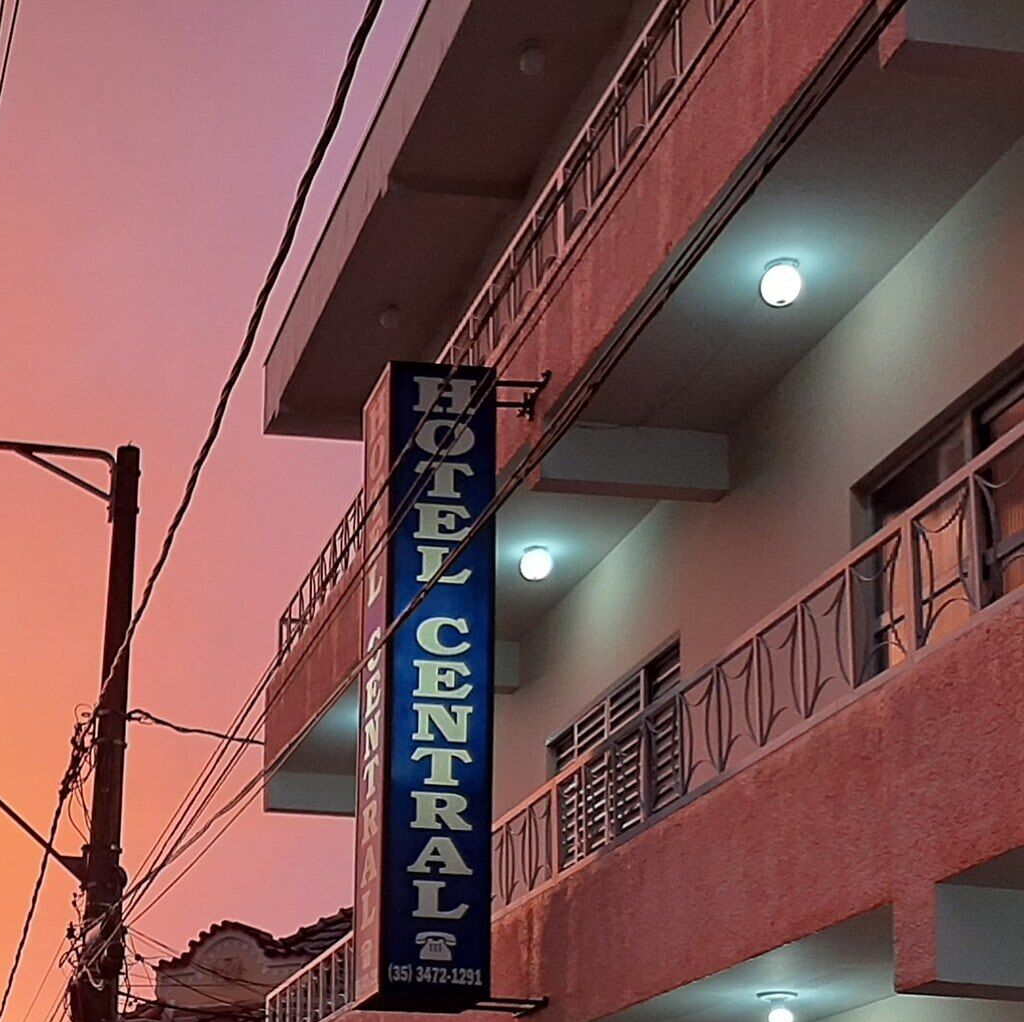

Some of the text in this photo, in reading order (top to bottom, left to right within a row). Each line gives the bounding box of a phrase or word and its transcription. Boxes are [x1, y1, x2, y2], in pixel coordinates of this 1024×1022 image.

[361, 626, 382, 930] CENTRAL
[406, 376, 476, 920] HOTEL CENTRAL
[388, 963, 482, 986] (35) 3472-1291
